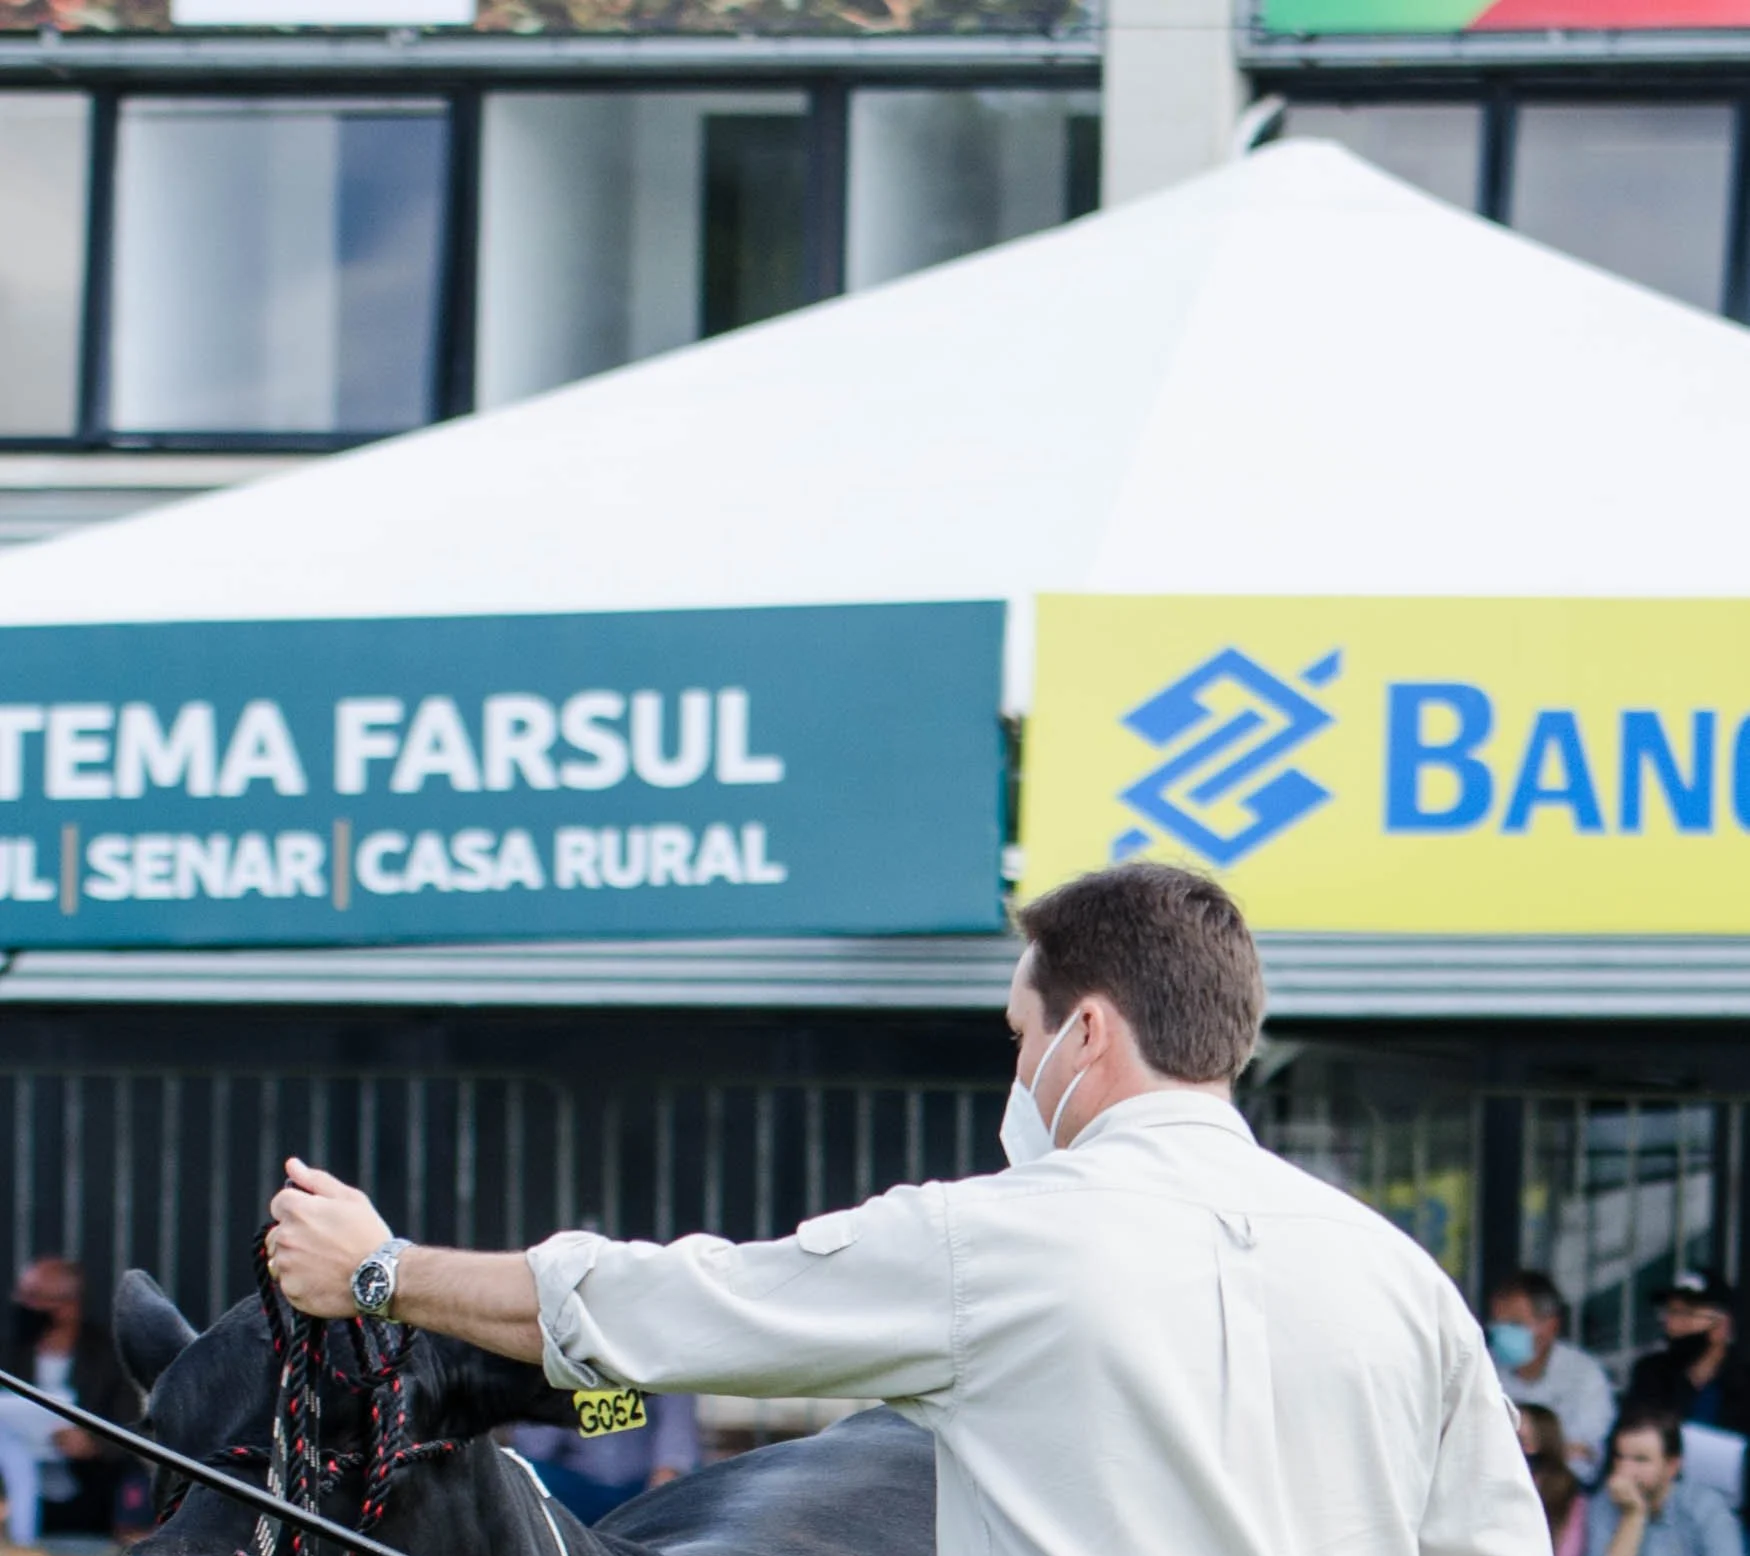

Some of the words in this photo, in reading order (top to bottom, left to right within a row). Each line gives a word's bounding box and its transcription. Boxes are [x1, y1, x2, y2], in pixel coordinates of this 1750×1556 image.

[0, 702, 307, 799] TEMA
[335, 687, 786, 794] FARSUL
[1383, 682, 1750, 834] BAN
[0, 835, 56, 900] L
[85, 832, 326, 899] SENAR
[356, 828, 545, 893] CASA
[555, 823, 788, 889] RURAL
